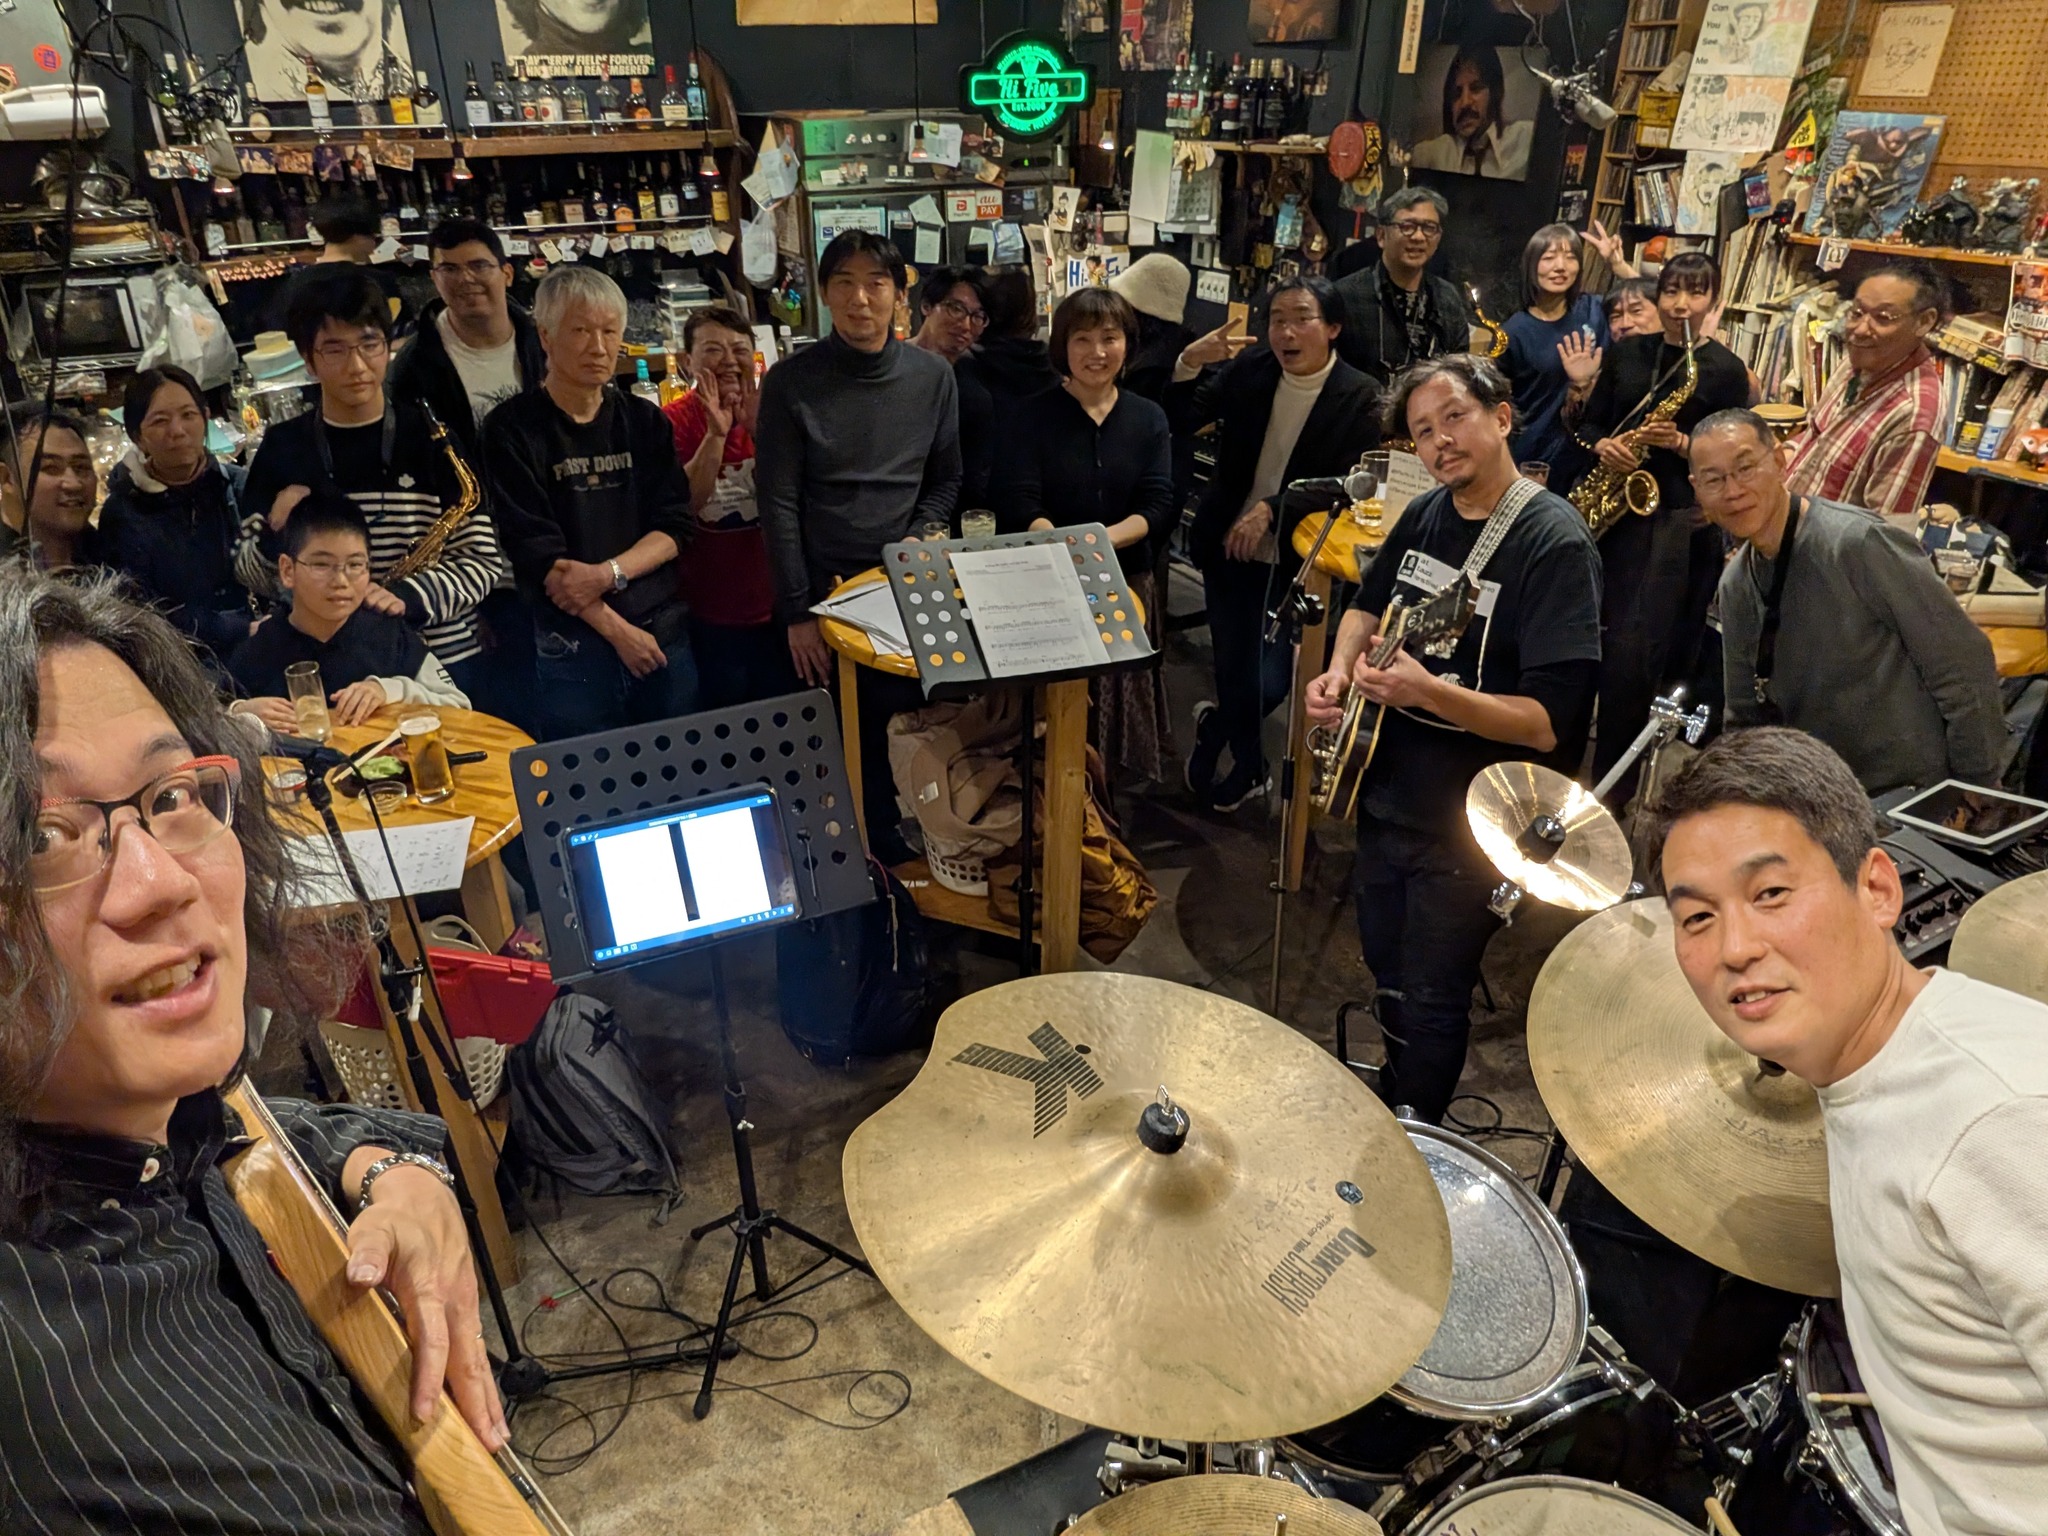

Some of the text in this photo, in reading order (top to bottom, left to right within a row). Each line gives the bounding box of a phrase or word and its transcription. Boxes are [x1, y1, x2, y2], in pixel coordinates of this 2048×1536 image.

[1711, 3, 1729, 12] Can
[1706, 21, 1721, 30] You
[1702, 37, 1718, 46] See
[1695, 57, 1709, 65] Me
[999, 78, 1059, 98] Hi Five
[980, 195, 997, 204] au
[981, 206, 997, 215] PAY
